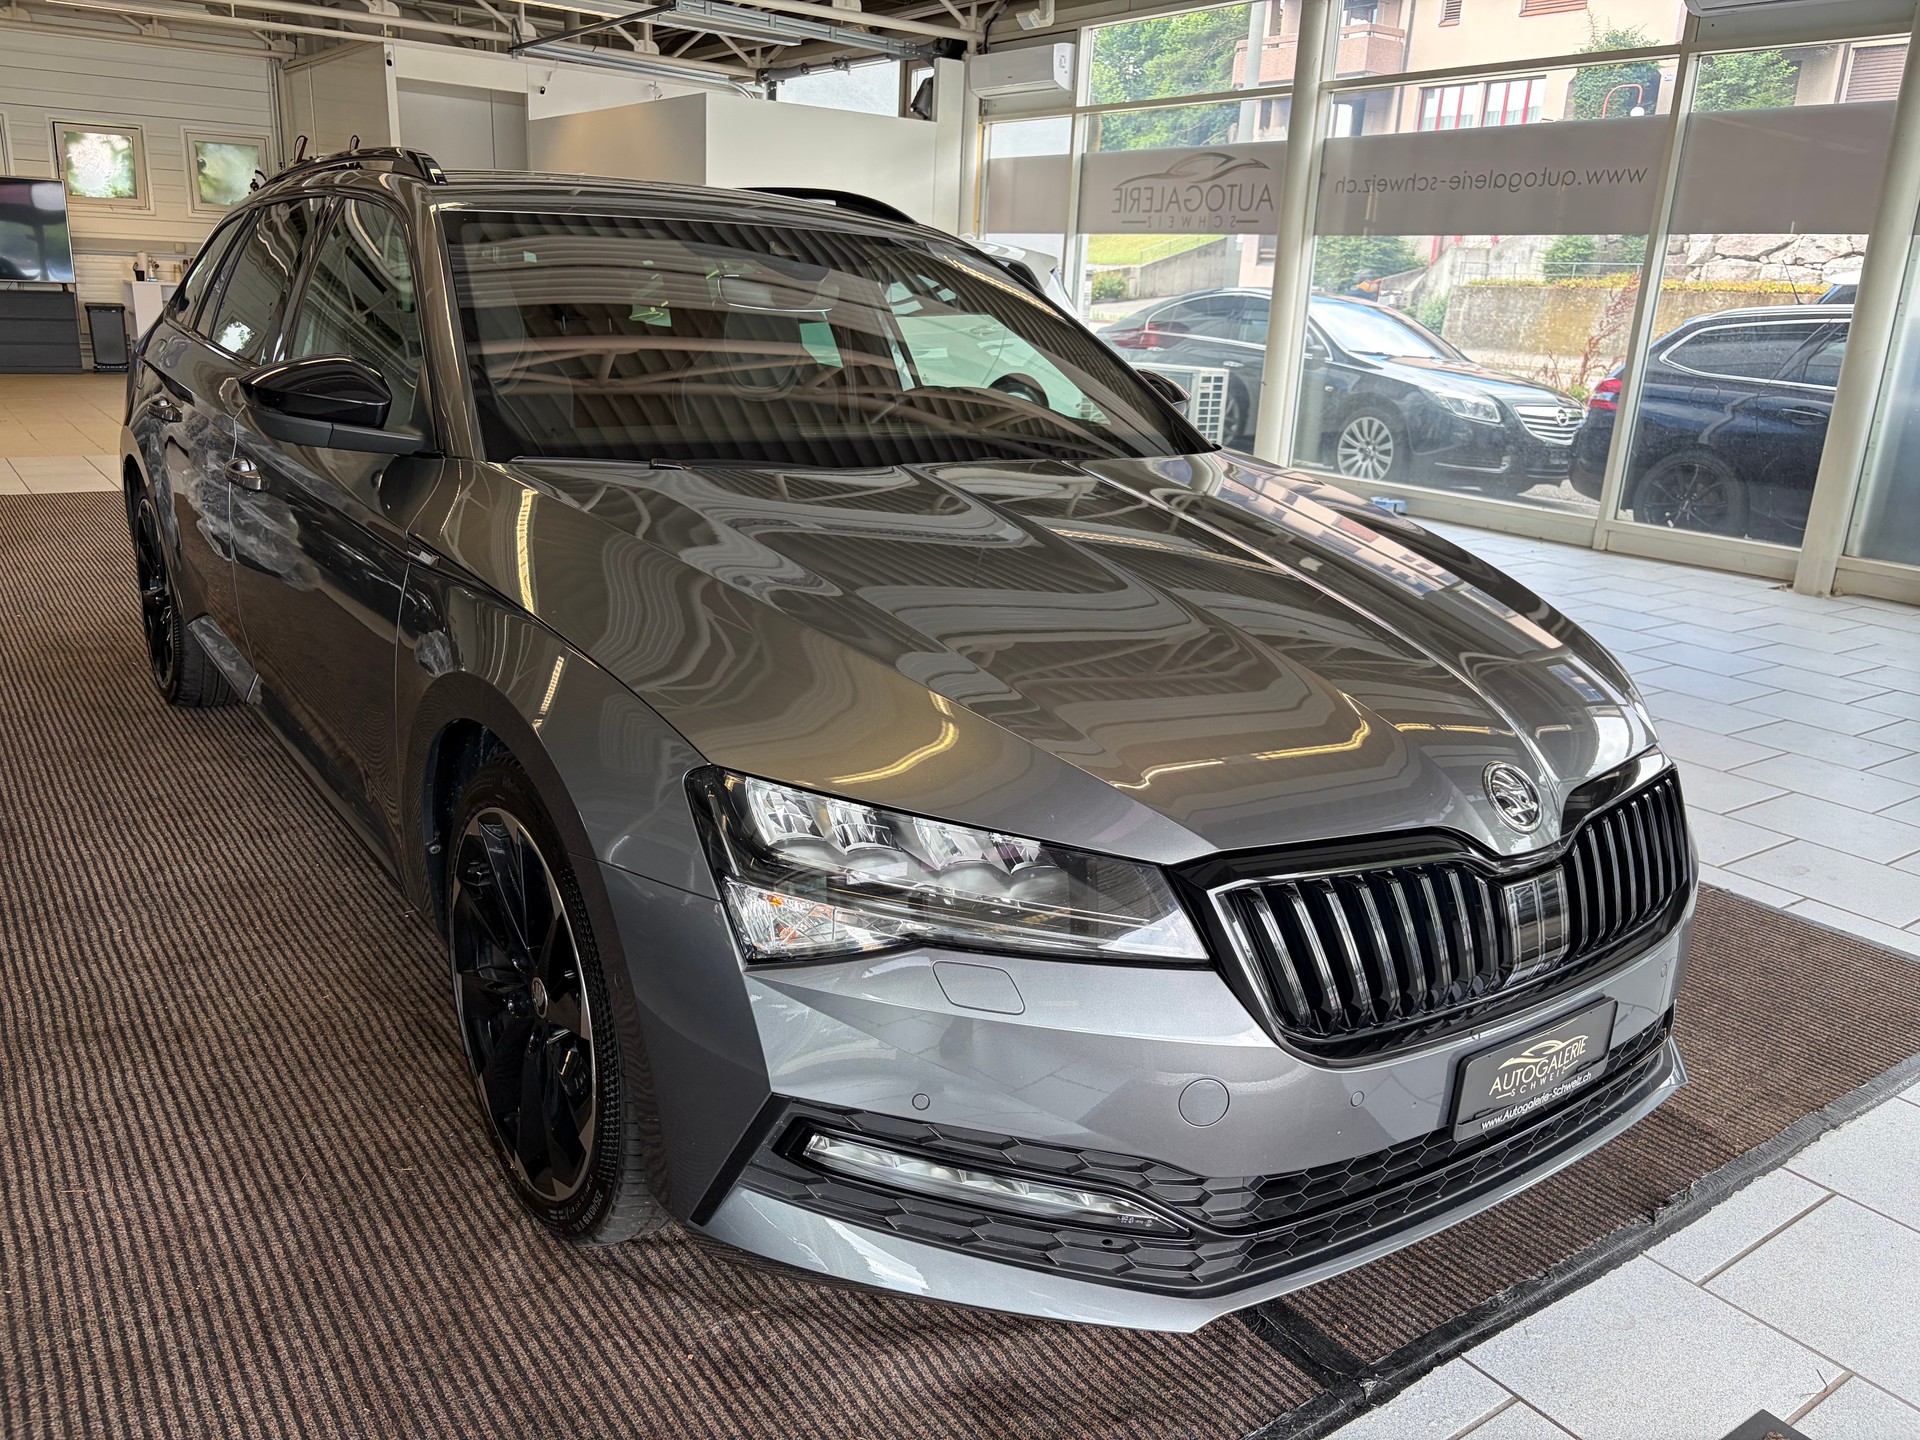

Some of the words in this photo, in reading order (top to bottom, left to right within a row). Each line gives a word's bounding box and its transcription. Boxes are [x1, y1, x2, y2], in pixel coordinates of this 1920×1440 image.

[1489, 1037, 1587, 1096] AUTOGALERIE
[1511, 1066, 1566, 1097] SCHWEIZ
[1481, 1071, 1592, 1130] www.Autogalerie-Schweiz.ch
